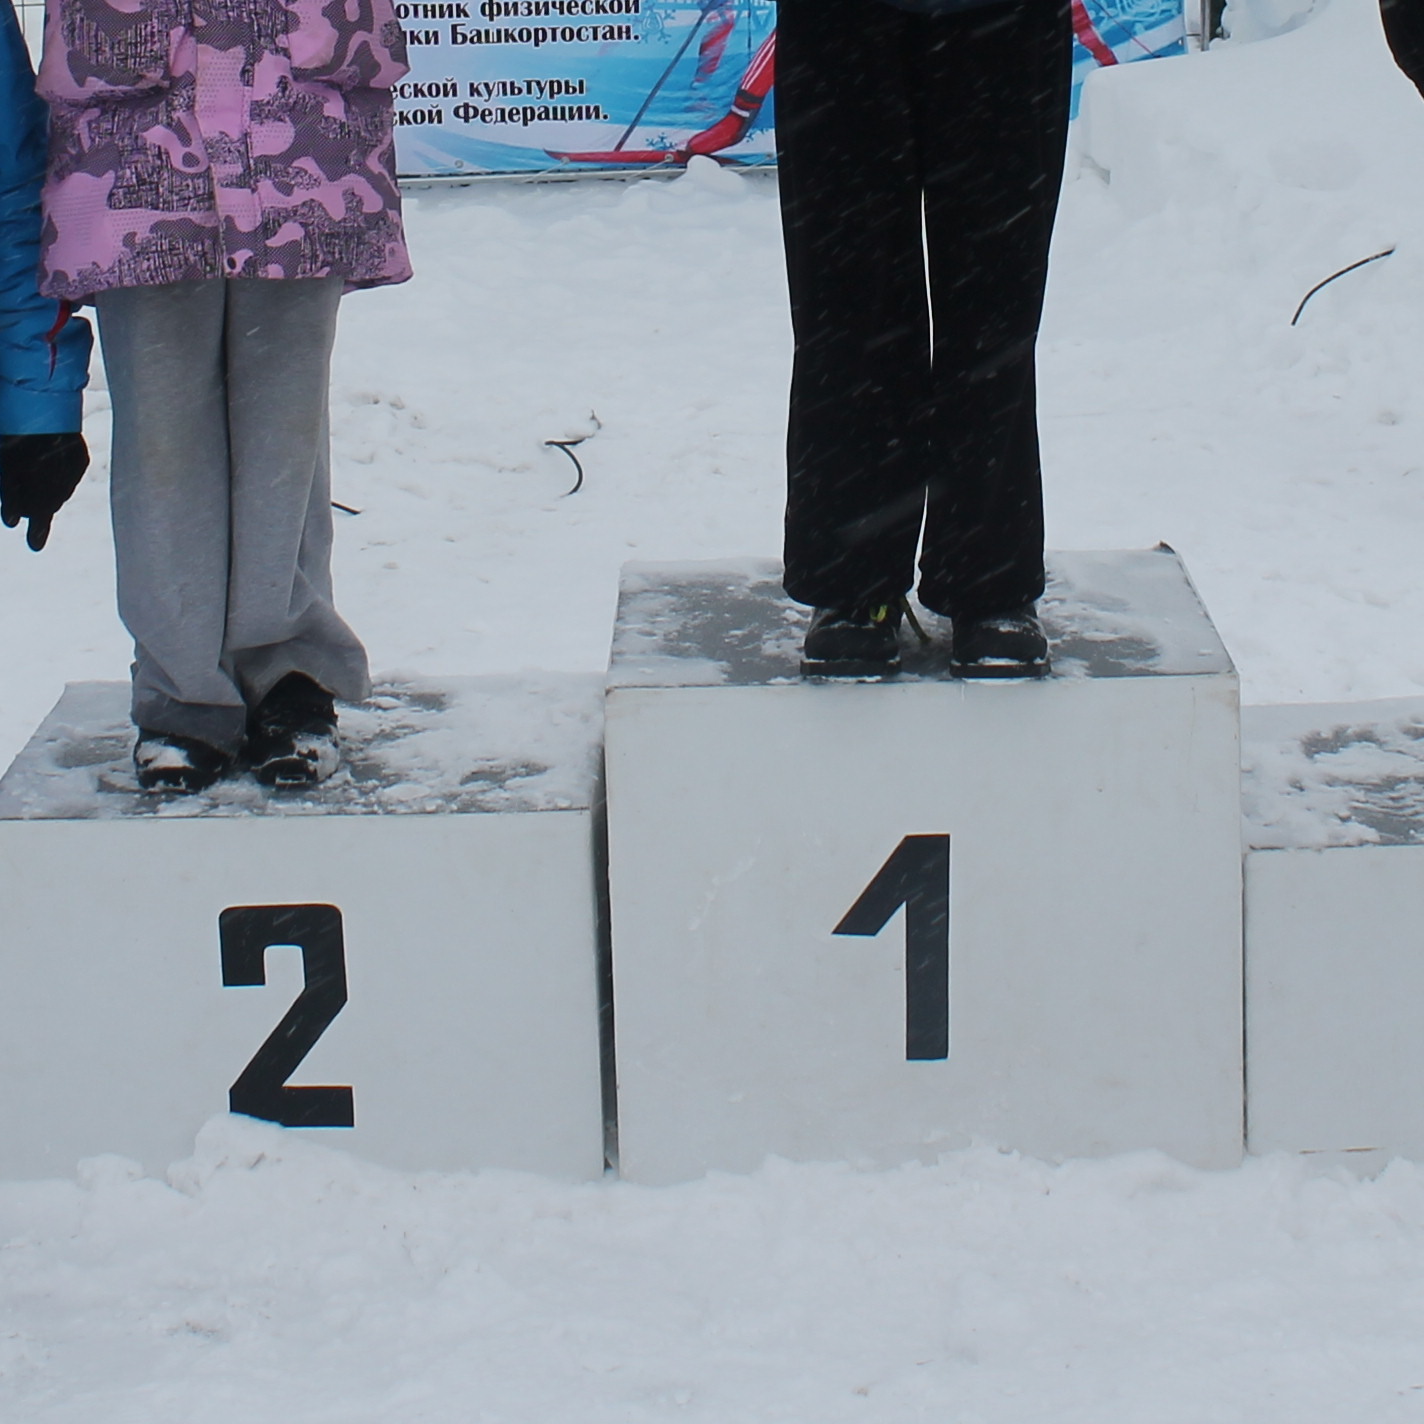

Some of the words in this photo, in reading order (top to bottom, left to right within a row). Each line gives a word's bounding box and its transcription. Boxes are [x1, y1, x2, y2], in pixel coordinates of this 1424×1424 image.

[450, 23, 640, 48] Башкортостан.
[469, 77, 585, 103] культуры
[453, 104, 609, 127] Федерации.
[832, 834, 950, 1061] 1
[218, 902, 355, 1128] 2
